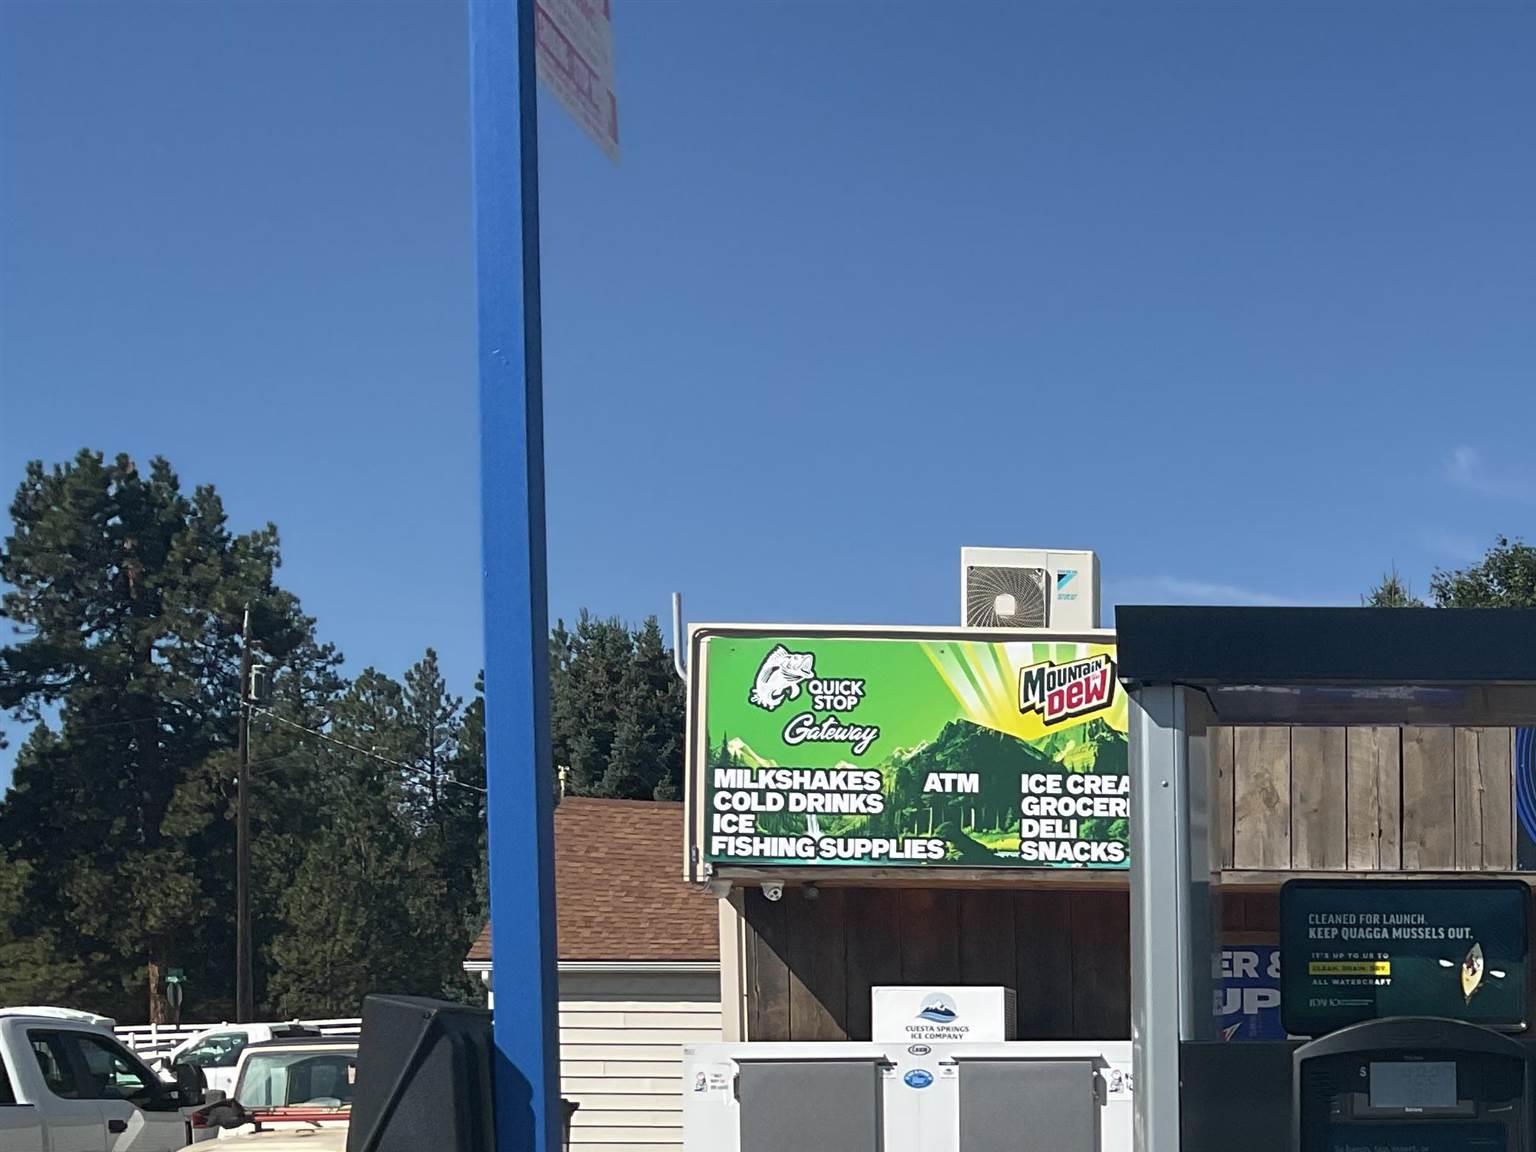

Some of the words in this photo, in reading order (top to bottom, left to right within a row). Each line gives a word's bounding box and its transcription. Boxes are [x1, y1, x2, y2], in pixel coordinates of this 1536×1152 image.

[808, 678, 864, 696] QUICK
[813, 695, 859, 711] STOP
[784, 714, 880, 754] Gateway
[714, 768, 881, 792] MILKSHAKES
[922, 772, 980, 794] ATM
[1021, 774, 1063, 794] ICE
[1066, 774, 1130, 795] CREA
[714, 792, 784, 814] COLD
[788, 793, 884, 815] DRINKS
[713, 813, 755, 834] ICE
[1021, 818, 1077, 839] DELI
[711, 836, 815, 859] FISHING
[819, 838, 945, 860] SUPPLIES
[1020, 840, 1125, 862] SNACKS
[1308, 913, 1356, 925] CLEANED
[1359, 914, 1380, 925] FOR
[1308, 927, 1338, 939] KEEP
[1341, 927, 1389, 940] QUAGGA
[1392, 927, 1445, 939] MUSSELS
[1448, 927, 1473, 940] OUT.
[1312, 978, 1329, 986] ALL
[1332, 978, 1392, 986] WATERCRAFT
